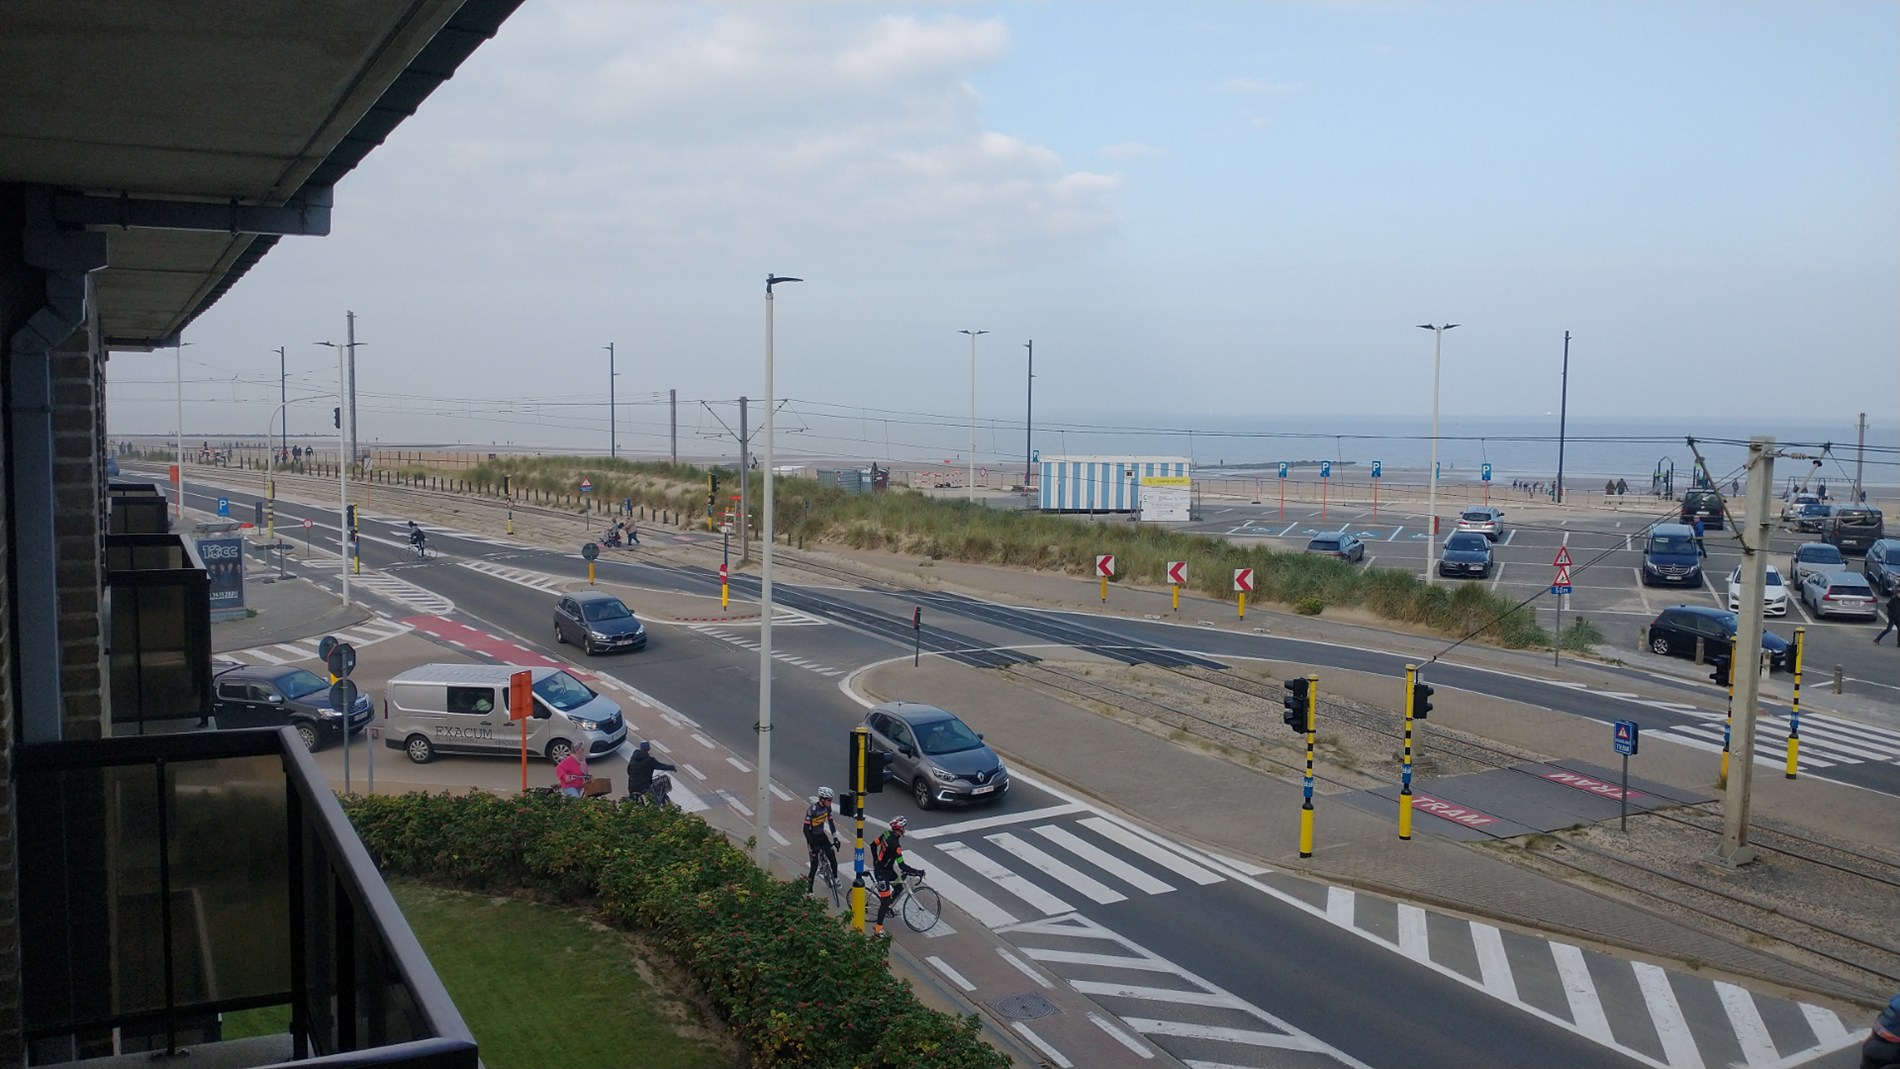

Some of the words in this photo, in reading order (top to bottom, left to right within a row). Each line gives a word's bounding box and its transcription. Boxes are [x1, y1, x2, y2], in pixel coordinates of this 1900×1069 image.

[220, 500, 226, 510] P
[435, 726, 493, 740] EXACUM
[1548, 773, 1632, 798] TRAM
[1412, 796, 1492, 824] TRAM
